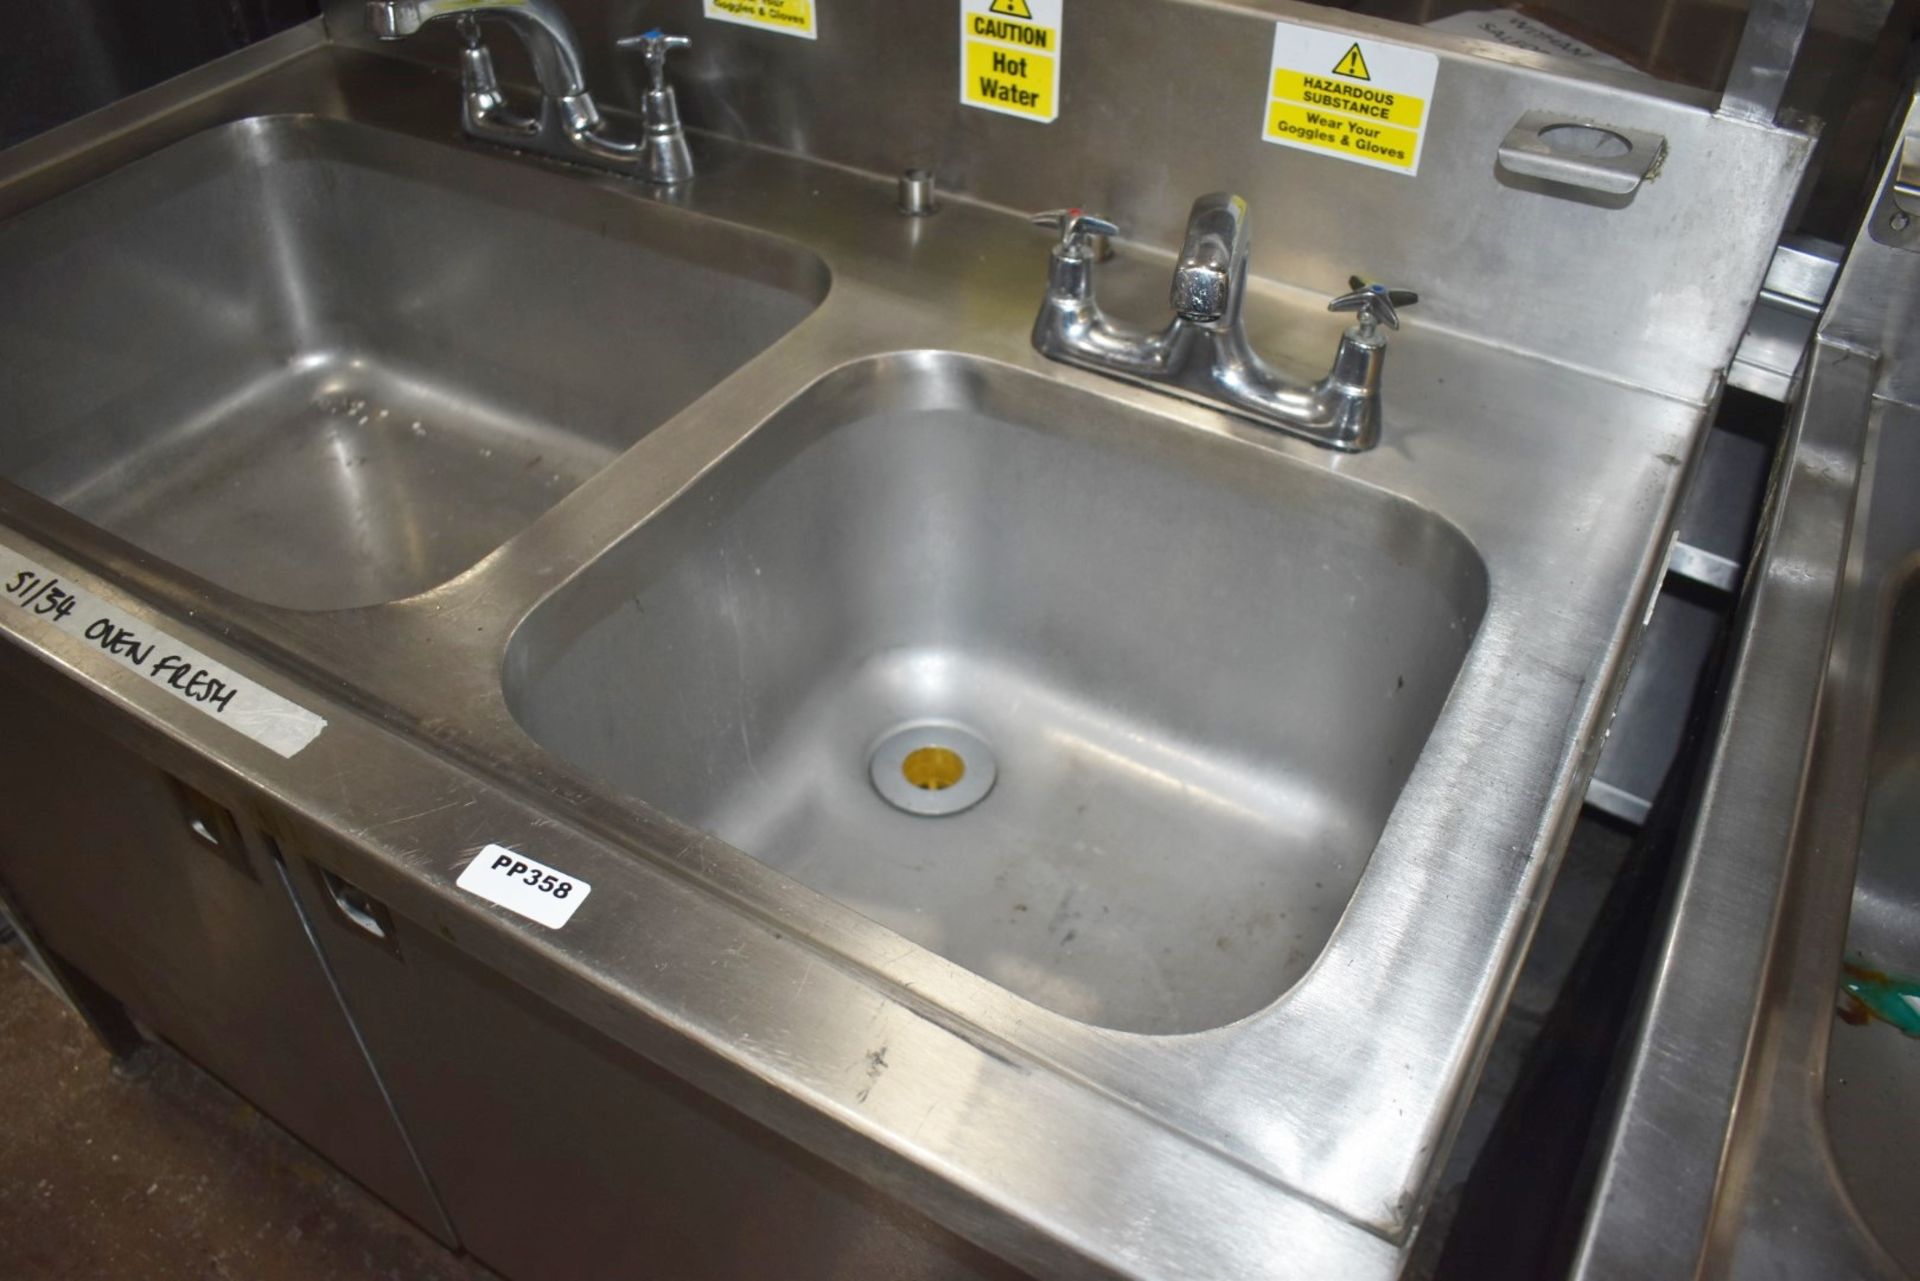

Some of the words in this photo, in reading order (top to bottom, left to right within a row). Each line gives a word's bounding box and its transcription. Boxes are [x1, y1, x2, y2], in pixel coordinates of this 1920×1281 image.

[758, 6, 766, 17] &
[769, 8, 805, 24] Gloves
[974, 16, 1047, 48] CAUTION
[993, 51, 1027, 78] Hot
[980, 76, 1040, 108] Water
[1303, 77, 1394, 106] HAZARDOUS
[1303, 91, 1390, 119] SUBSTANCE
[1278, 120, 1335, 143] Goggles
[1340, 135, 1350, 146] &
[1356, 138, 1405, 160] Gloves
[1306, 112, 1343, 130] Wear
[1348, 121, 1381, 138] Your
[84, 618, 155, 666] OVEN
[150, 655, 238, 713] FRESH
[491, 855, 573, 899] PP358
